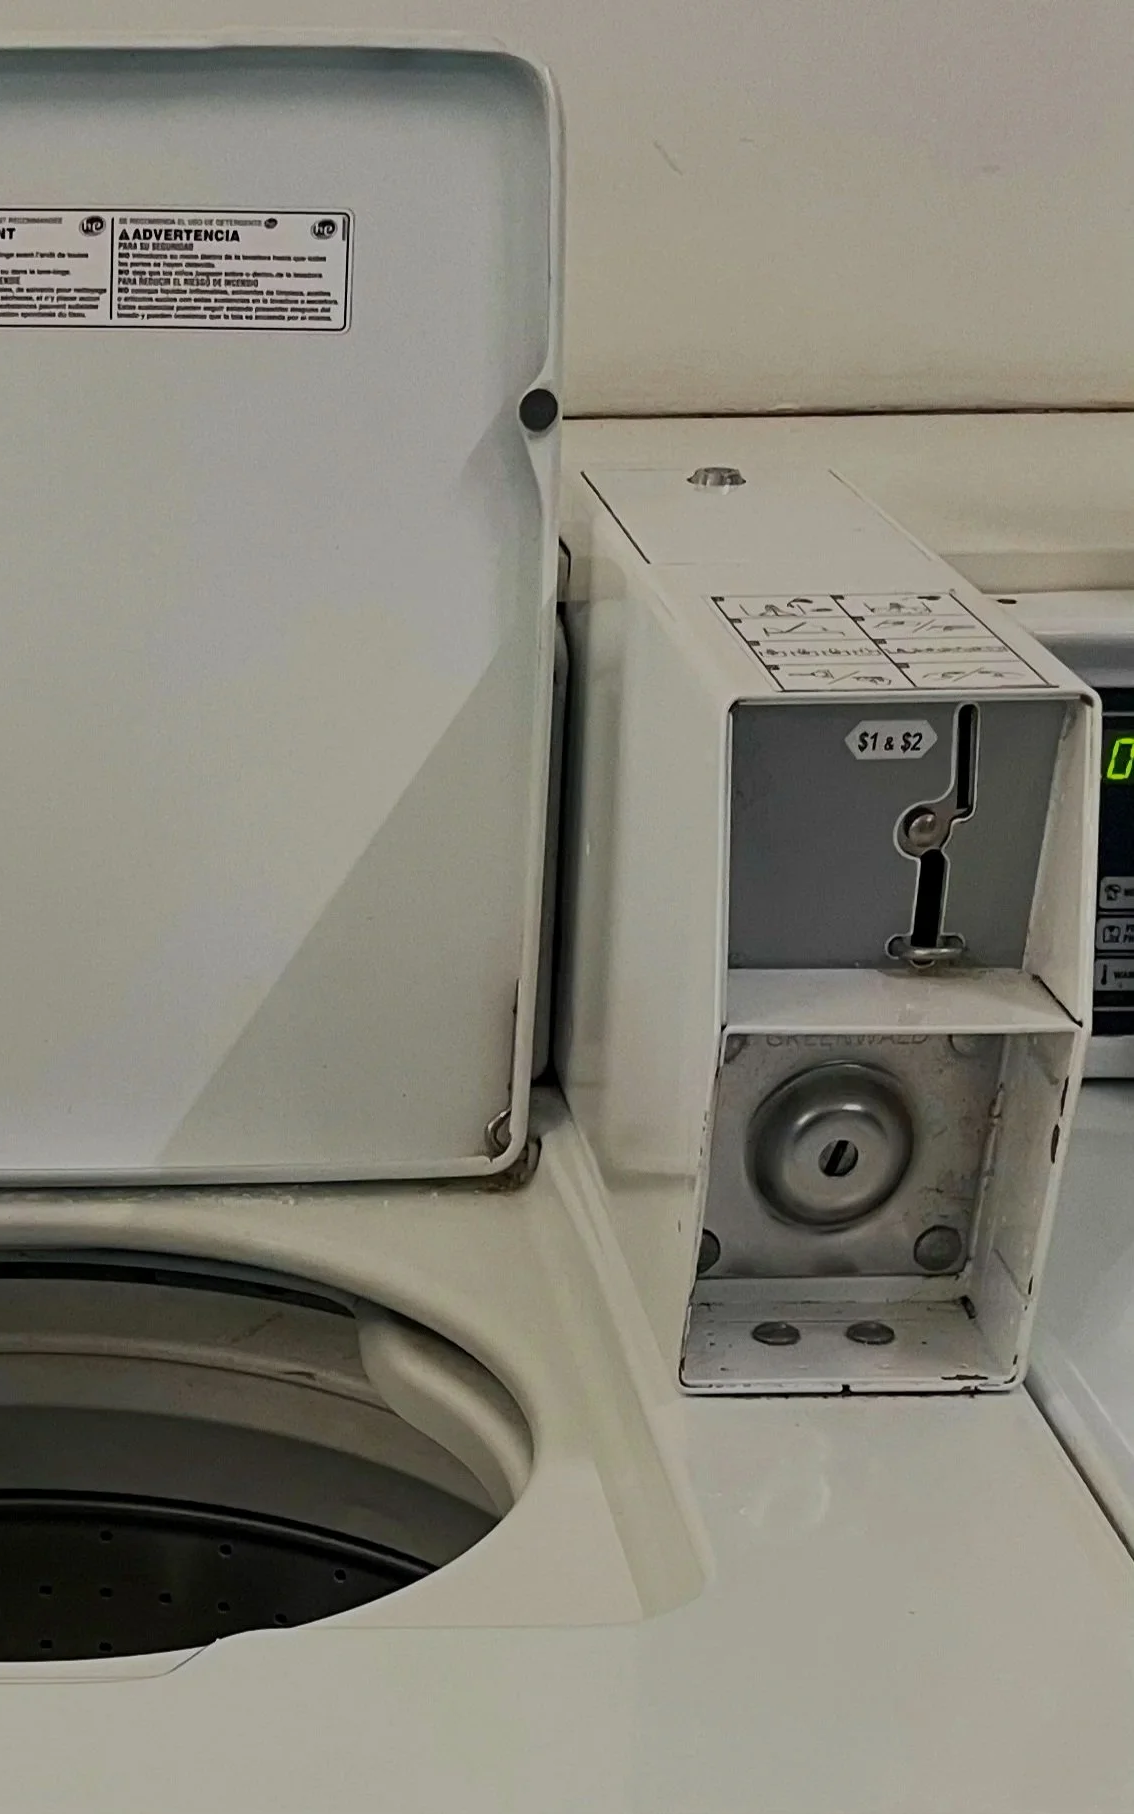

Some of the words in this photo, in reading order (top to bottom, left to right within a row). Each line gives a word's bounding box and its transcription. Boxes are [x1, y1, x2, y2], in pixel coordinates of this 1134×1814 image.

[132, 228, 240, 241] ADVERTENCIA
[118, 242, 137, 250] PARA
[140, 242, 149, 250] SU
[858, 730, 878, 754] $1
[884, 737, 894, 751] &
[901, 730, 923, 754] $2
